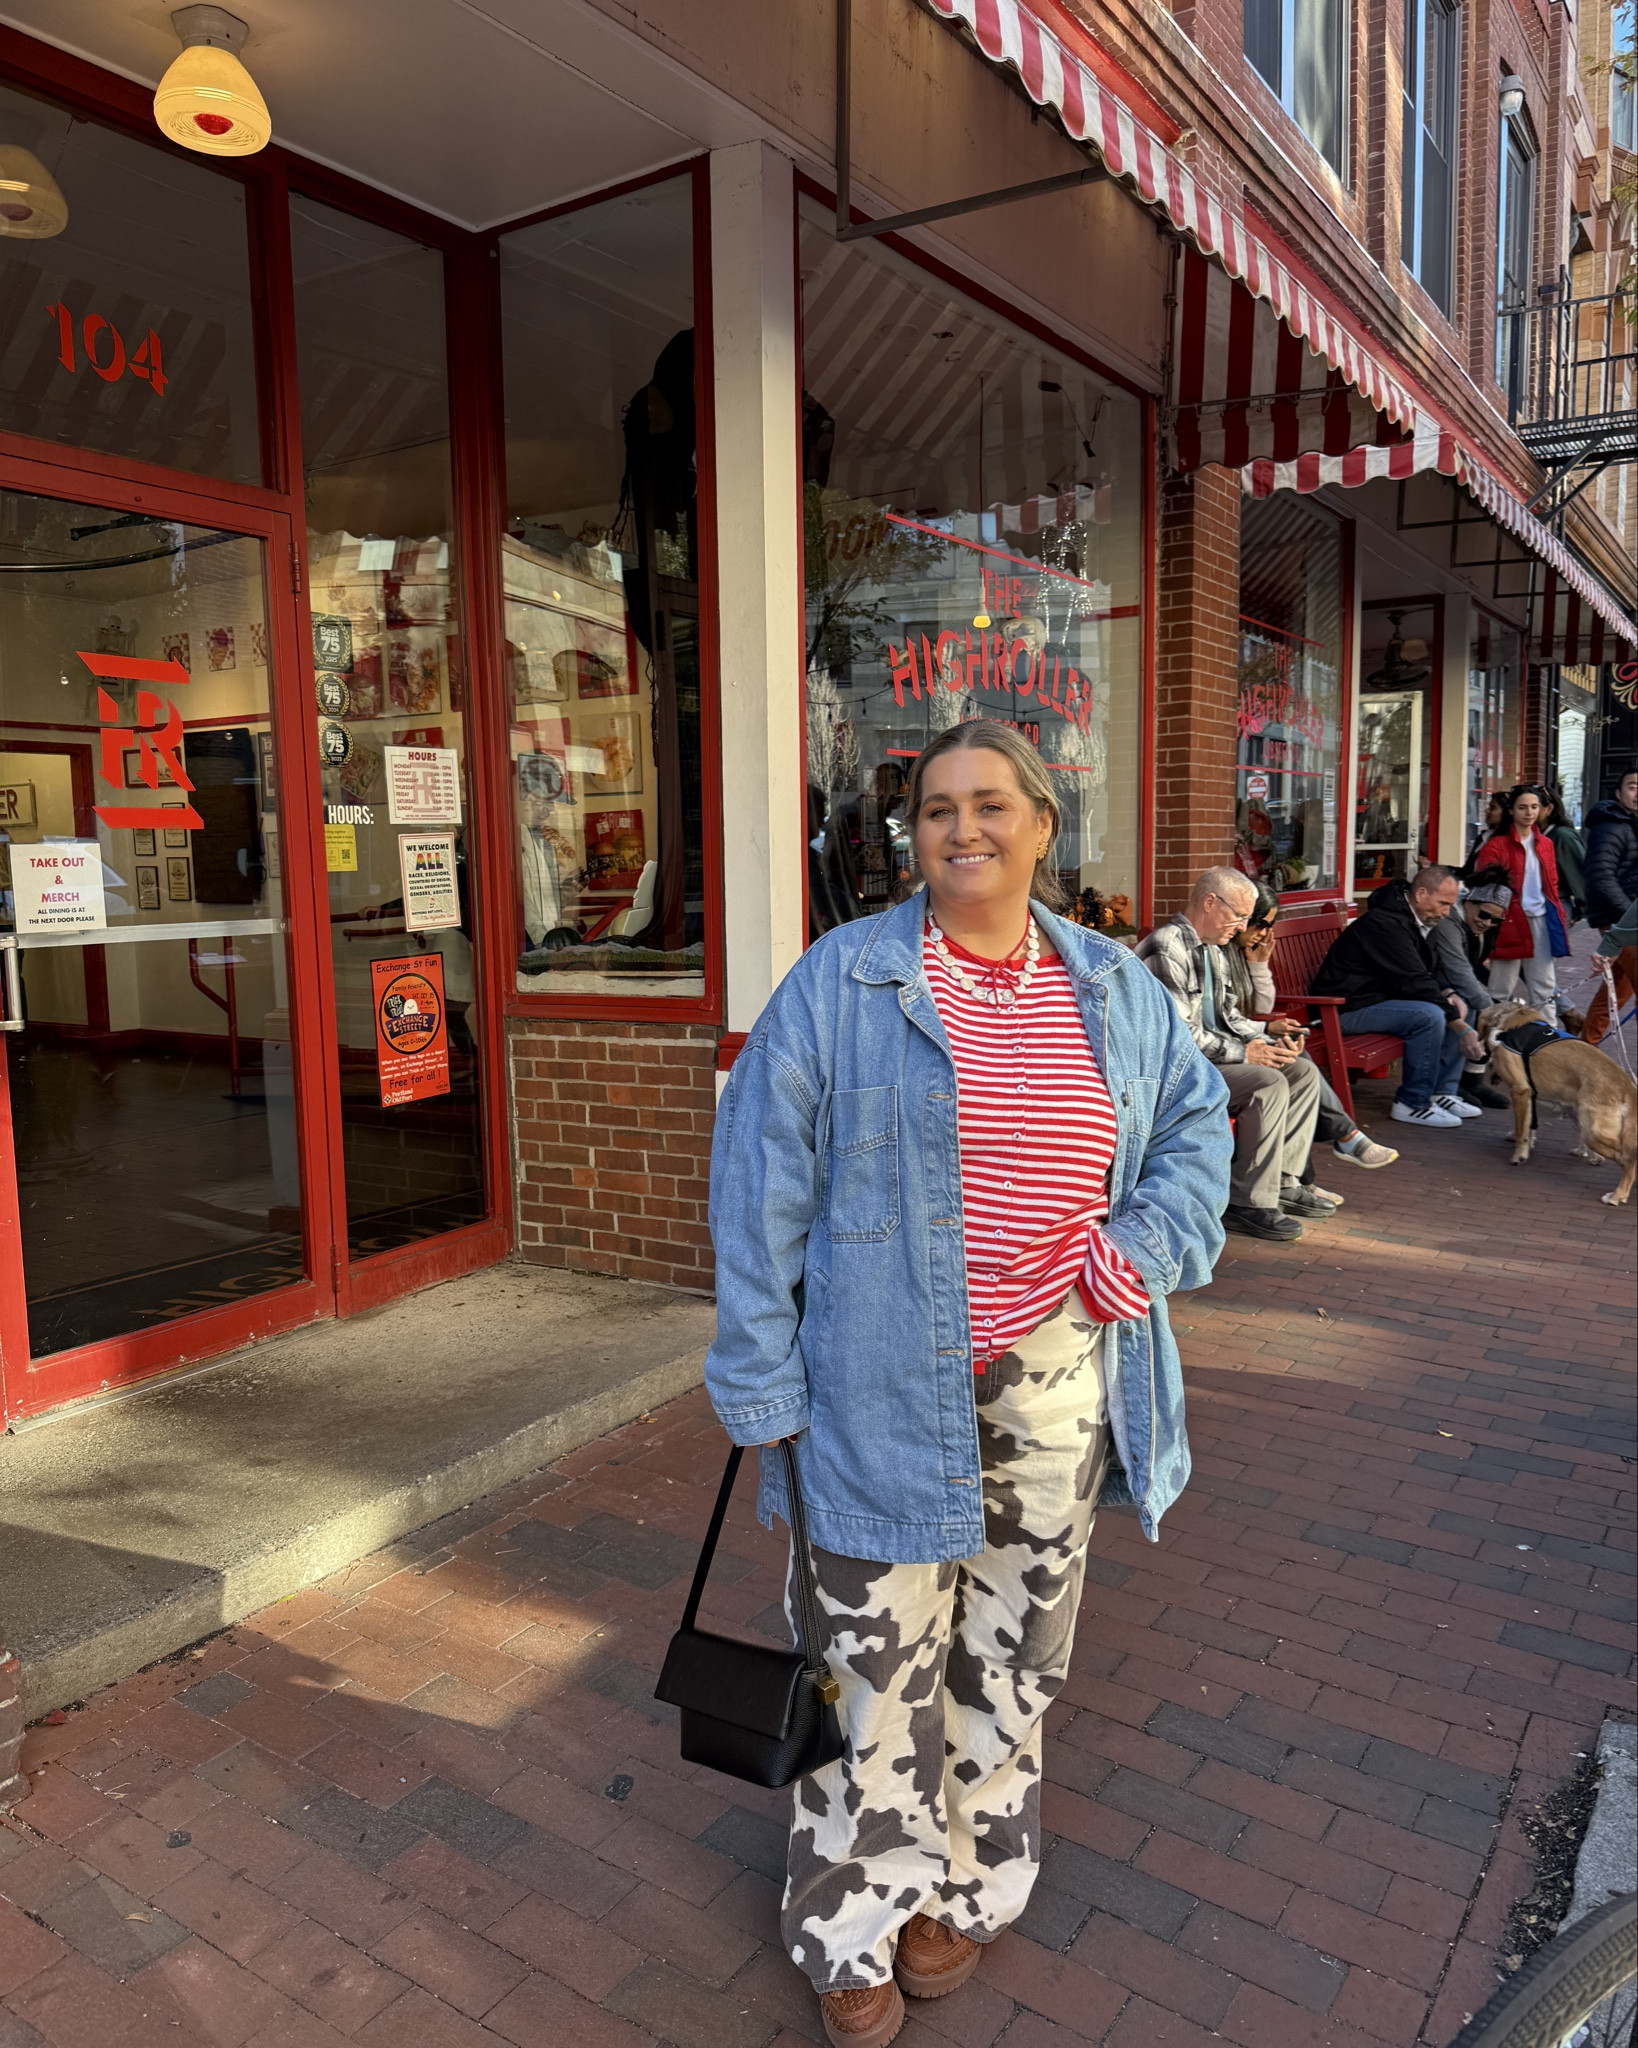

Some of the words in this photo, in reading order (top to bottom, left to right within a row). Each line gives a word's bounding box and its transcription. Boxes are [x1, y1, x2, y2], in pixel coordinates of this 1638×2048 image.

[46, 300, 169, 397] 104
[980, 567, 1022, 618] THE
[320, 627, 339, 637] Best
[321, 636, 340, 653] 75
[1273, 641, 1293, 674] THE
[324, 684, 339, 692] Best
[888, 627, 1093, 737] HIGHROLLER
[324, 692, 341, 705] 75
[97, 686, 196, 791] HR
[327, 732, 343, 740] Best
[327, 740, 344, 753] 75
[408, 752, 437, 761] HOURS
[328, 805, 374, 825] HOURS:
[30, 858, 58, 868] TAKE
[62, 857, 85, 867] OUT
[416, 852, 444, 870] ALL
[55, 875, 64, 885] &
[41, 892, 80, 903] MERCH
[377, 963, 410, 973] Exchange
[414, 960, 422, 968] St
[425, 958, 437, 967] Fun
[392, 1015, 428, 1033] EXCHANGE
[400, 1024, 422, 1034] STREET
[389, 1079, 408, 1089] Free
[411, 1075, 424, 1084] for
[427, 1071, 435, 1081] all
[392, 1088, 413, 1098] Portland
